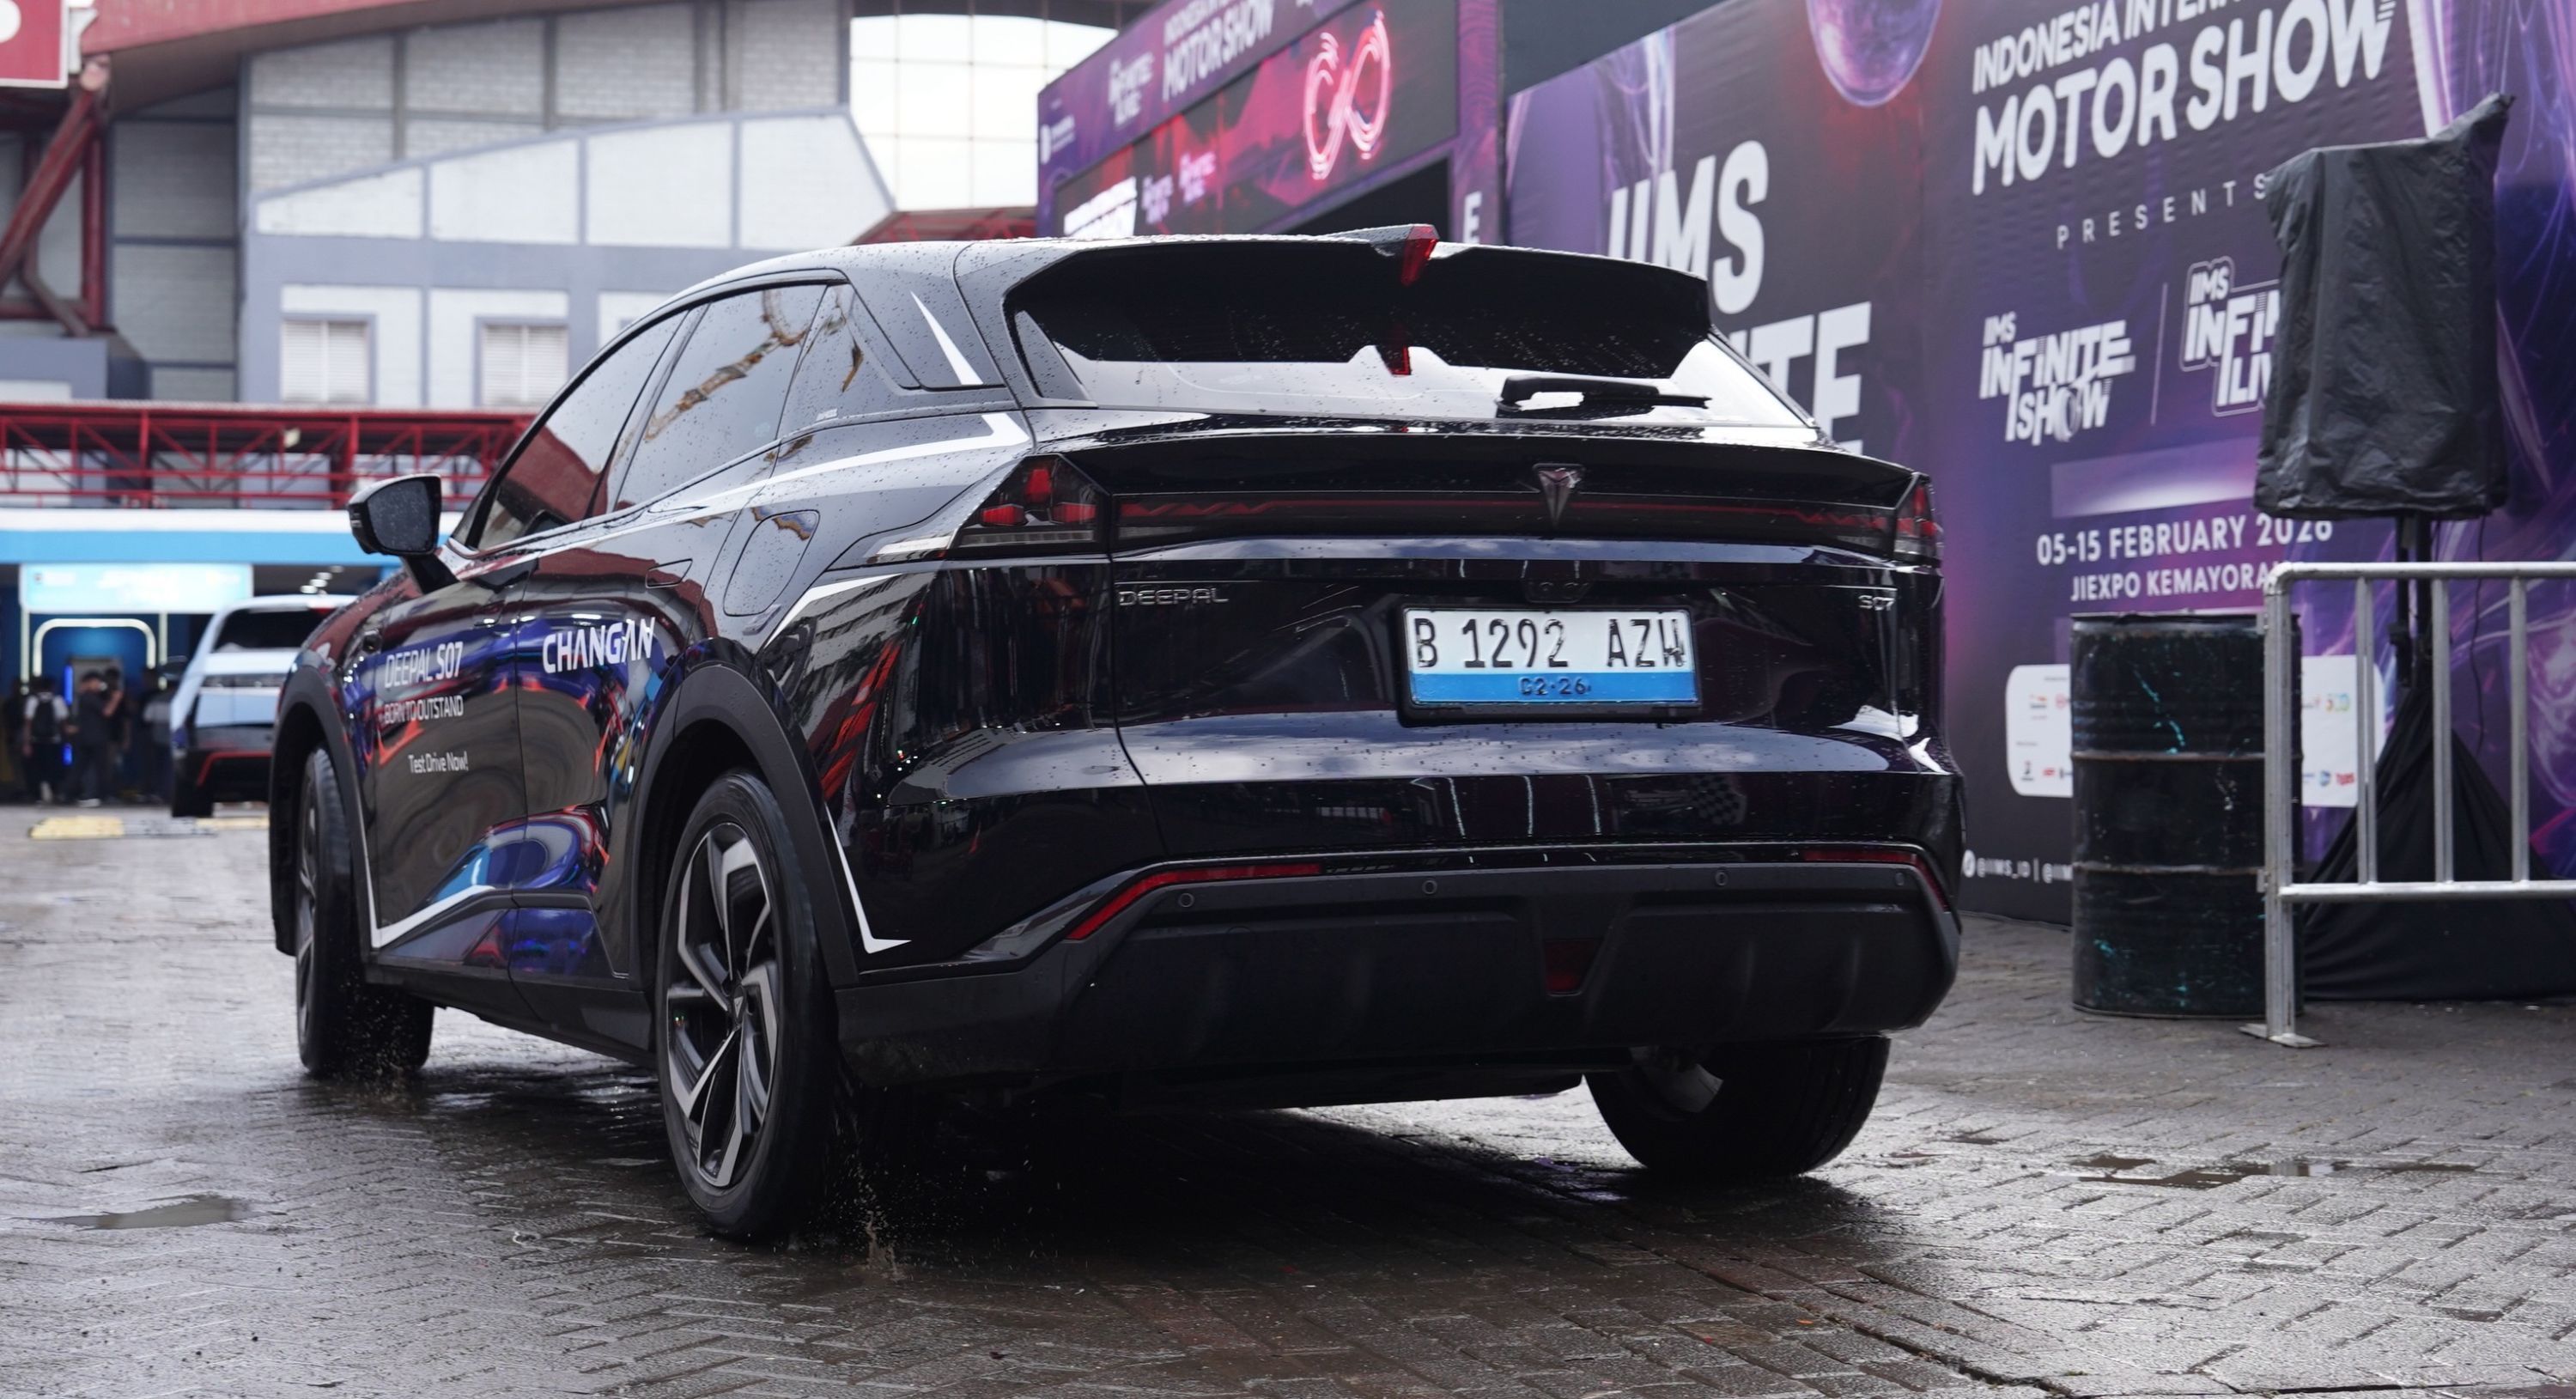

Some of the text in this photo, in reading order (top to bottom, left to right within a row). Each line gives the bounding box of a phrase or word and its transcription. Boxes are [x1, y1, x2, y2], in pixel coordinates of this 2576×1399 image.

[1972, 0, 2121, 94] INDONESIA
[1972, 0, 2397, 195] MOTOR SHOW
[2057, 173, 2269, 251] PRESENTS
[2190, 266, 2230, 304] IIMS
[1979, 319, 2136, 441] INFINITE
[2016, 378, 2113, 446] SHOW
[2037, 530, 2102, 565] 05-15
[2108, 515, 2246, 559] FEBRUARY
[1118, 588, 1230, 606] DEEPAL
[2070, 571, 2141, 601] JIEXPO
[385, 641, 464, 688] DEEPAL S07
[542, 616, 655, 673] CHANGAN
[1414, 617, 1437, 667] B
[1461, 617, 1569, 668] 1292
[384, 694, 464, 725] BORN TO OUTSTAND
[408, 750, 469, 774] Test Drive Now!
